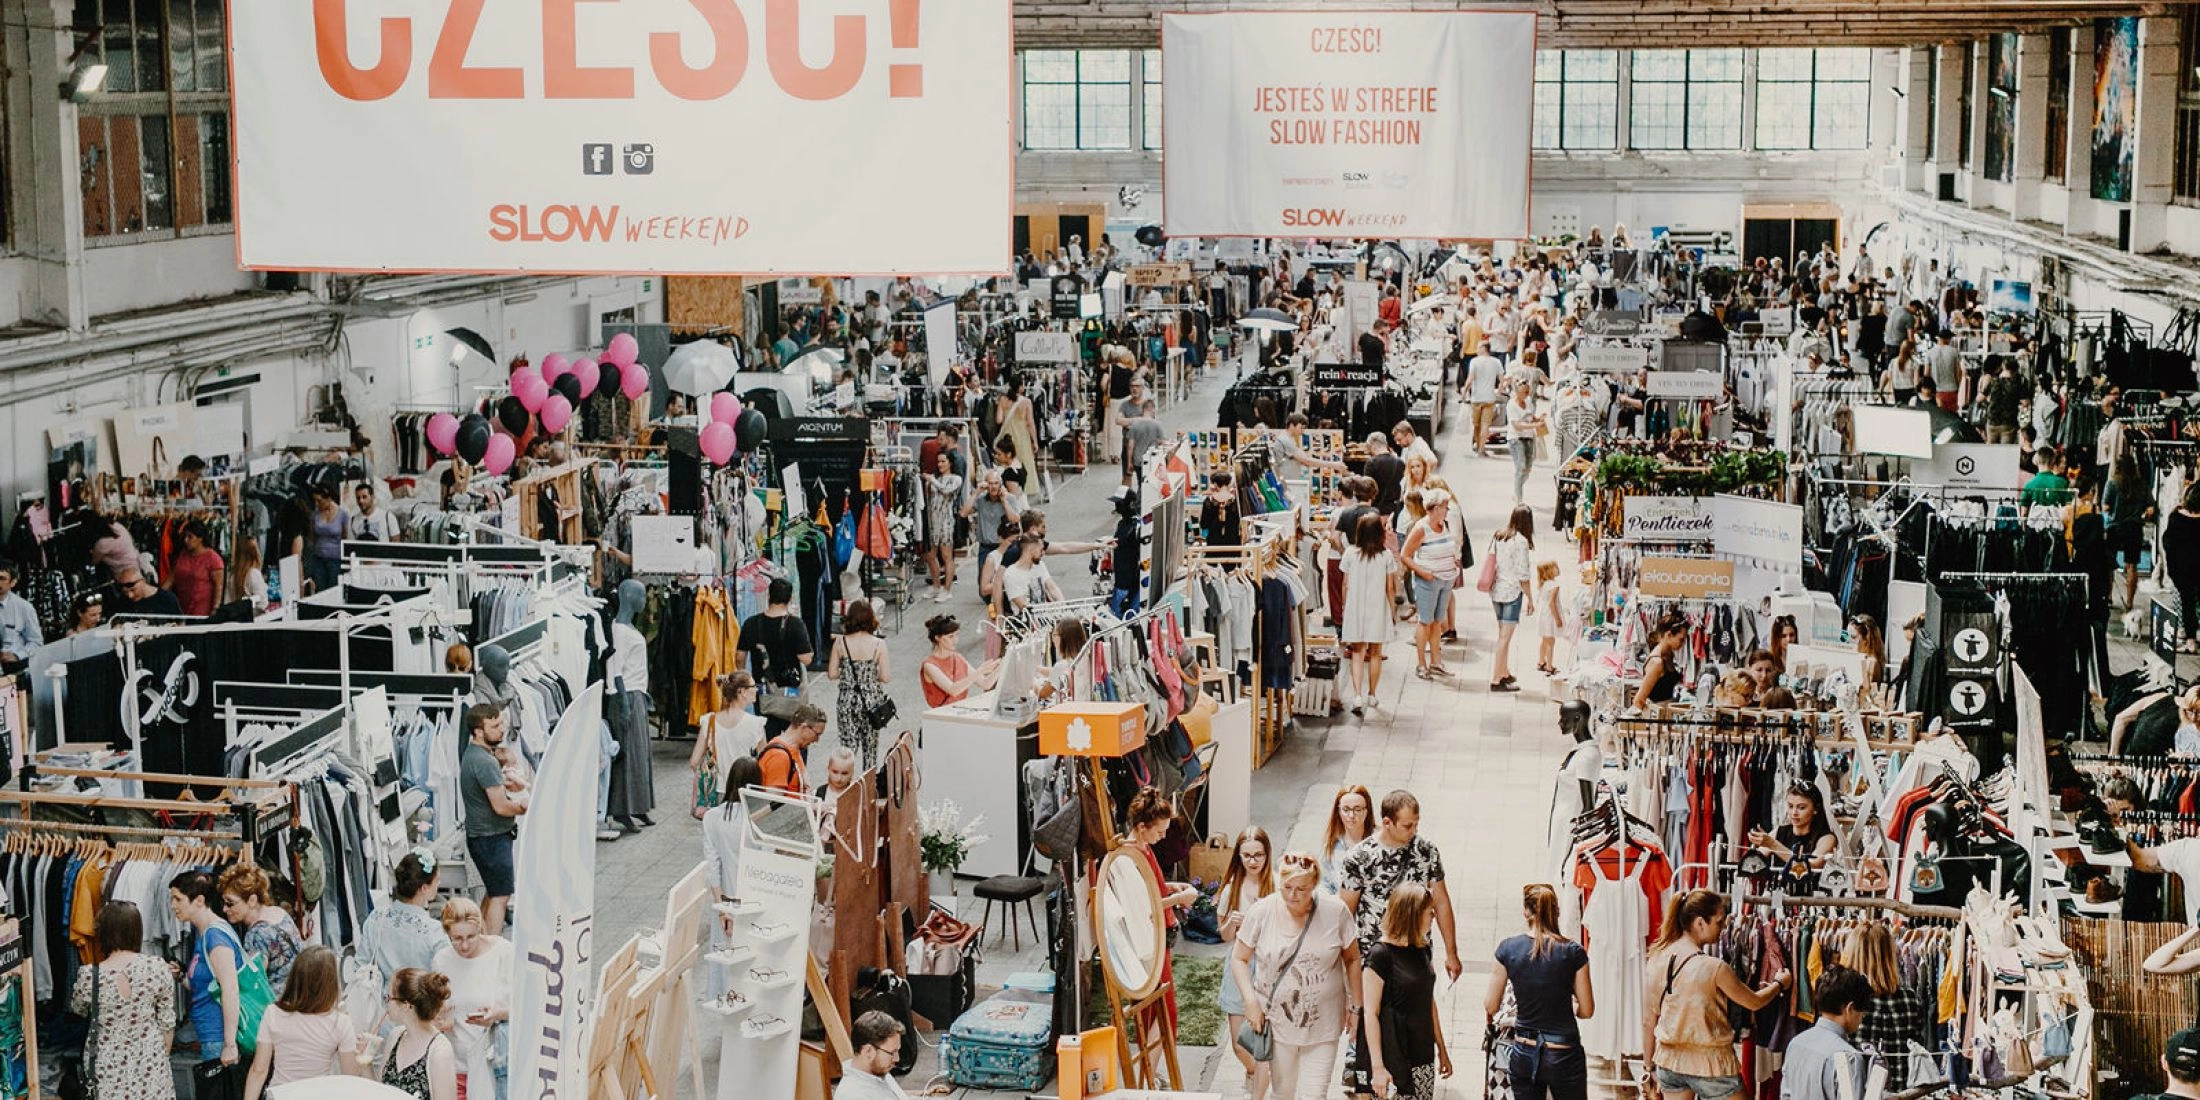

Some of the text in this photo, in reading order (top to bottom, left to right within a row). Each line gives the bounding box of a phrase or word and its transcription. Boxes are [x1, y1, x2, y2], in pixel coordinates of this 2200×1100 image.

[1311, 22, 1381, 53] CZEŚĆ!
[1254, 82, 1437, 112] JESTEŚ W STREFIE
[1270, 120, 1420, 144] SLOW FASHION
[1342, 172, 1370, 181] SLOW
[488, 204, 750, 246] SLOW WEEKEND
[1282, 208, 1408, 228] SLOW WEEKEND
[1628, 514, 1714, 531] Pentliczek
